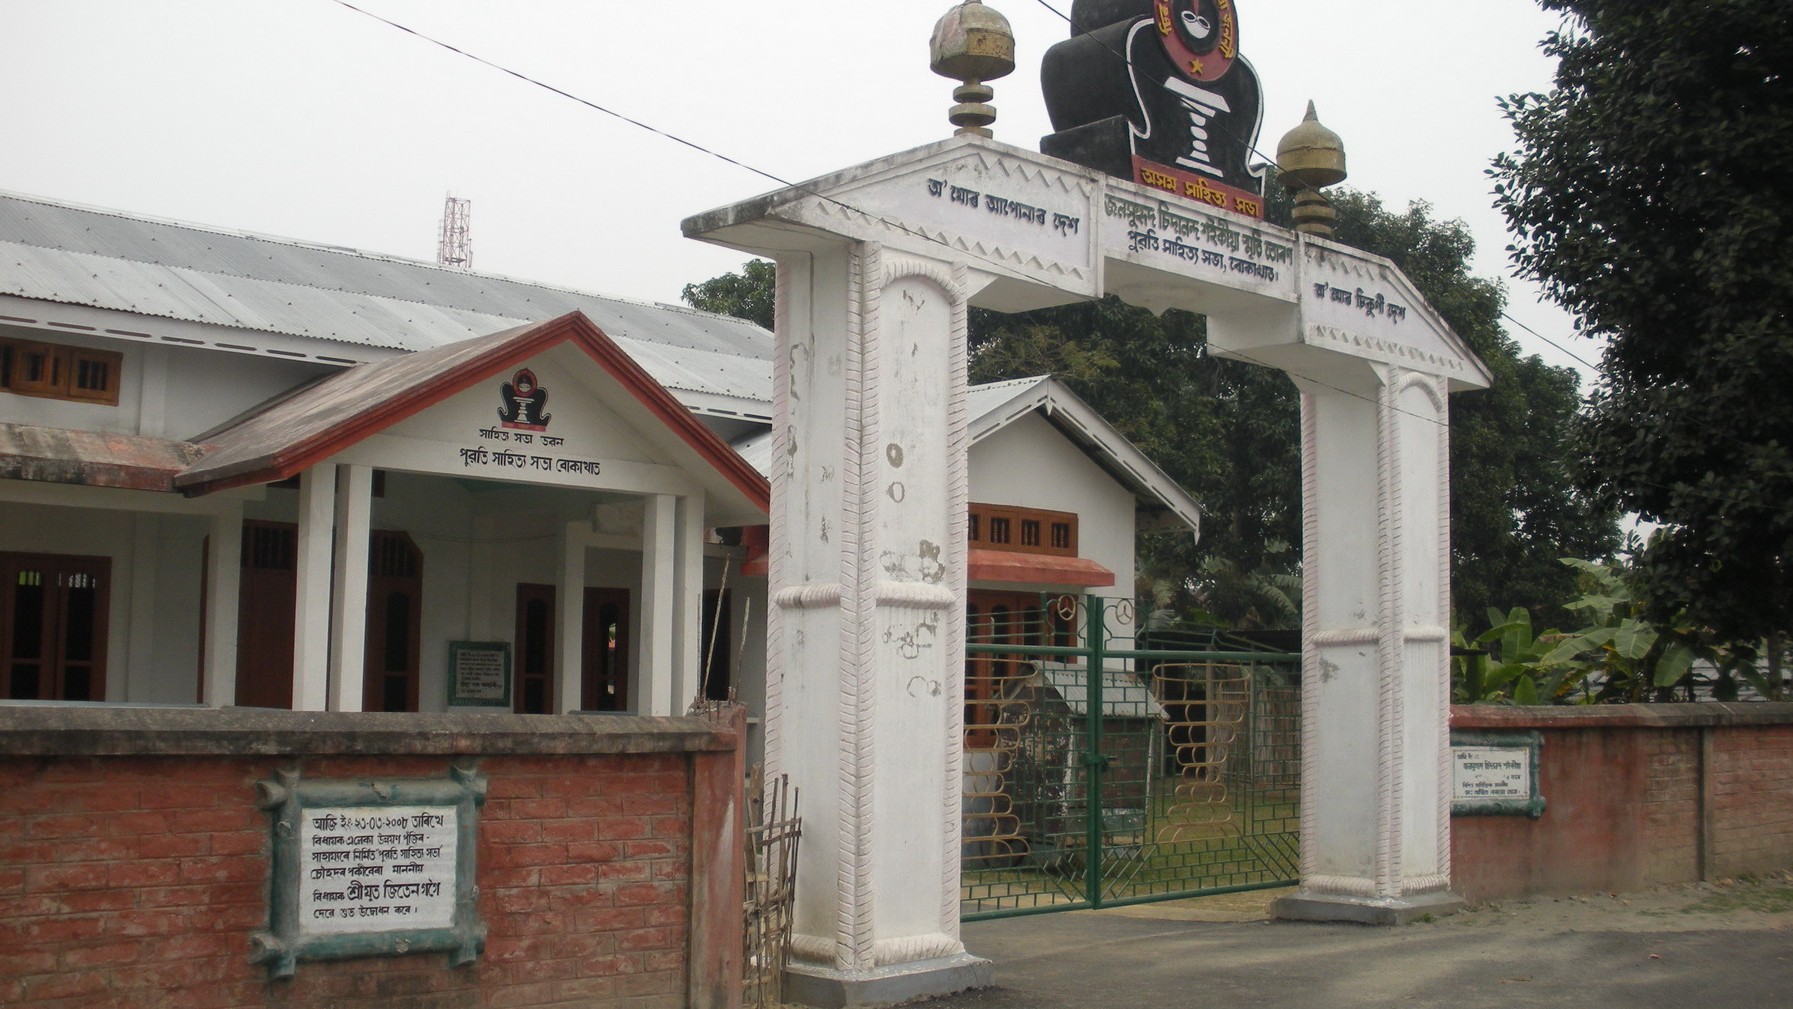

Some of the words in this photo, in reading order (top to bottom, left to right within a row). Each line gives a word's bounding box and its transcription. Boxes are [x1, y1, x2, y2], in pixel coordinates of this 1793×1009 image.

[1142, 168, 1177, 191] অসম
[1184, 178, 1226, 208] সাহিত্য
[1235, 197, 1258, 216] সভা
[950, 185, 979, 208] মোৰ
[985, 194, 1046, 225] আপোনাৰ
[1052, 212, 1079, 237] দেশ
[1162, 236, 1198, 264] সাহিত্য
[1201, 249, 1227, 272] সভা,
[1387, 303, 1406, 325] দেশ
[479, 426, 509, 441] সাহিত্য
[514, 433, 532, 444] সভা
[492, 449, 526, 468] সাহিত্য
[530, 456, 552, 470] সভা
[556, 459, 600, 475] বোকাখাত
[313, 814, 336, 831] আজি
[411, 812, 443, 828] তাৰিখে
[313, 835, 345, 846] বিধায়ক
[346, 835, 373, 845] এলেকা
[400, 846, 423, 859] সাহিত্য
[392, 861, 424, 873] মাননীয়
[313, 890, 345, 901] বিধায়ক
[384, 879, 419, 899] জিতেন
[421, 879, 440, 897] গগৈ
[340, 908, 354, 918] শুভ
